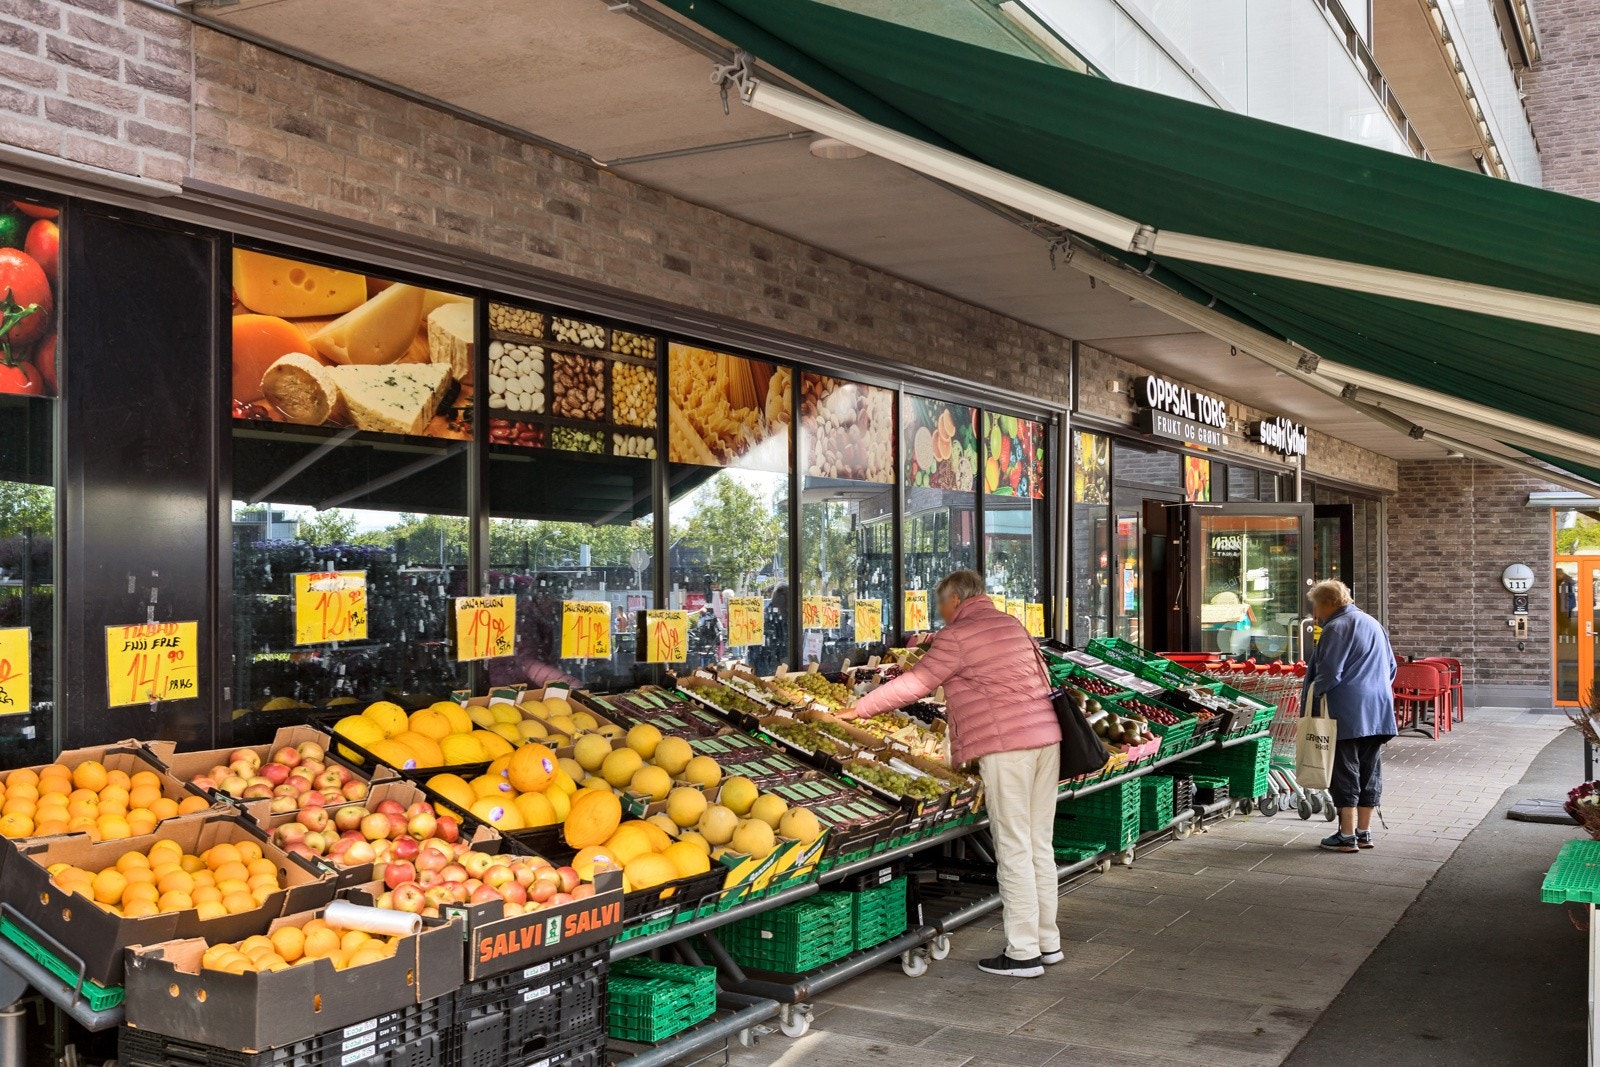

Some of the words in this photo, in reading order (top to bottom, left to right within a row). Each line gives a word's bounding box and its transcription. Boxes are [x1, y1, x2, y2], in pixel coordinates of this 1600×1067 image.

[1146, 375, 1195, 420] OPPSAL
[1196, 393, 1227, 429] TORG
[1157, 415, 1181, 436] FRUKT
[1184, 424, 1195, 440] OG
[1198, 427, 1221, 446] GRØNT
[1509, 581, 1527, 589] 111
[151, 637, 181, 650] EPLE
[479, 923, 542, 963] SALVI
[564, 901, 620, 938] SALVI
